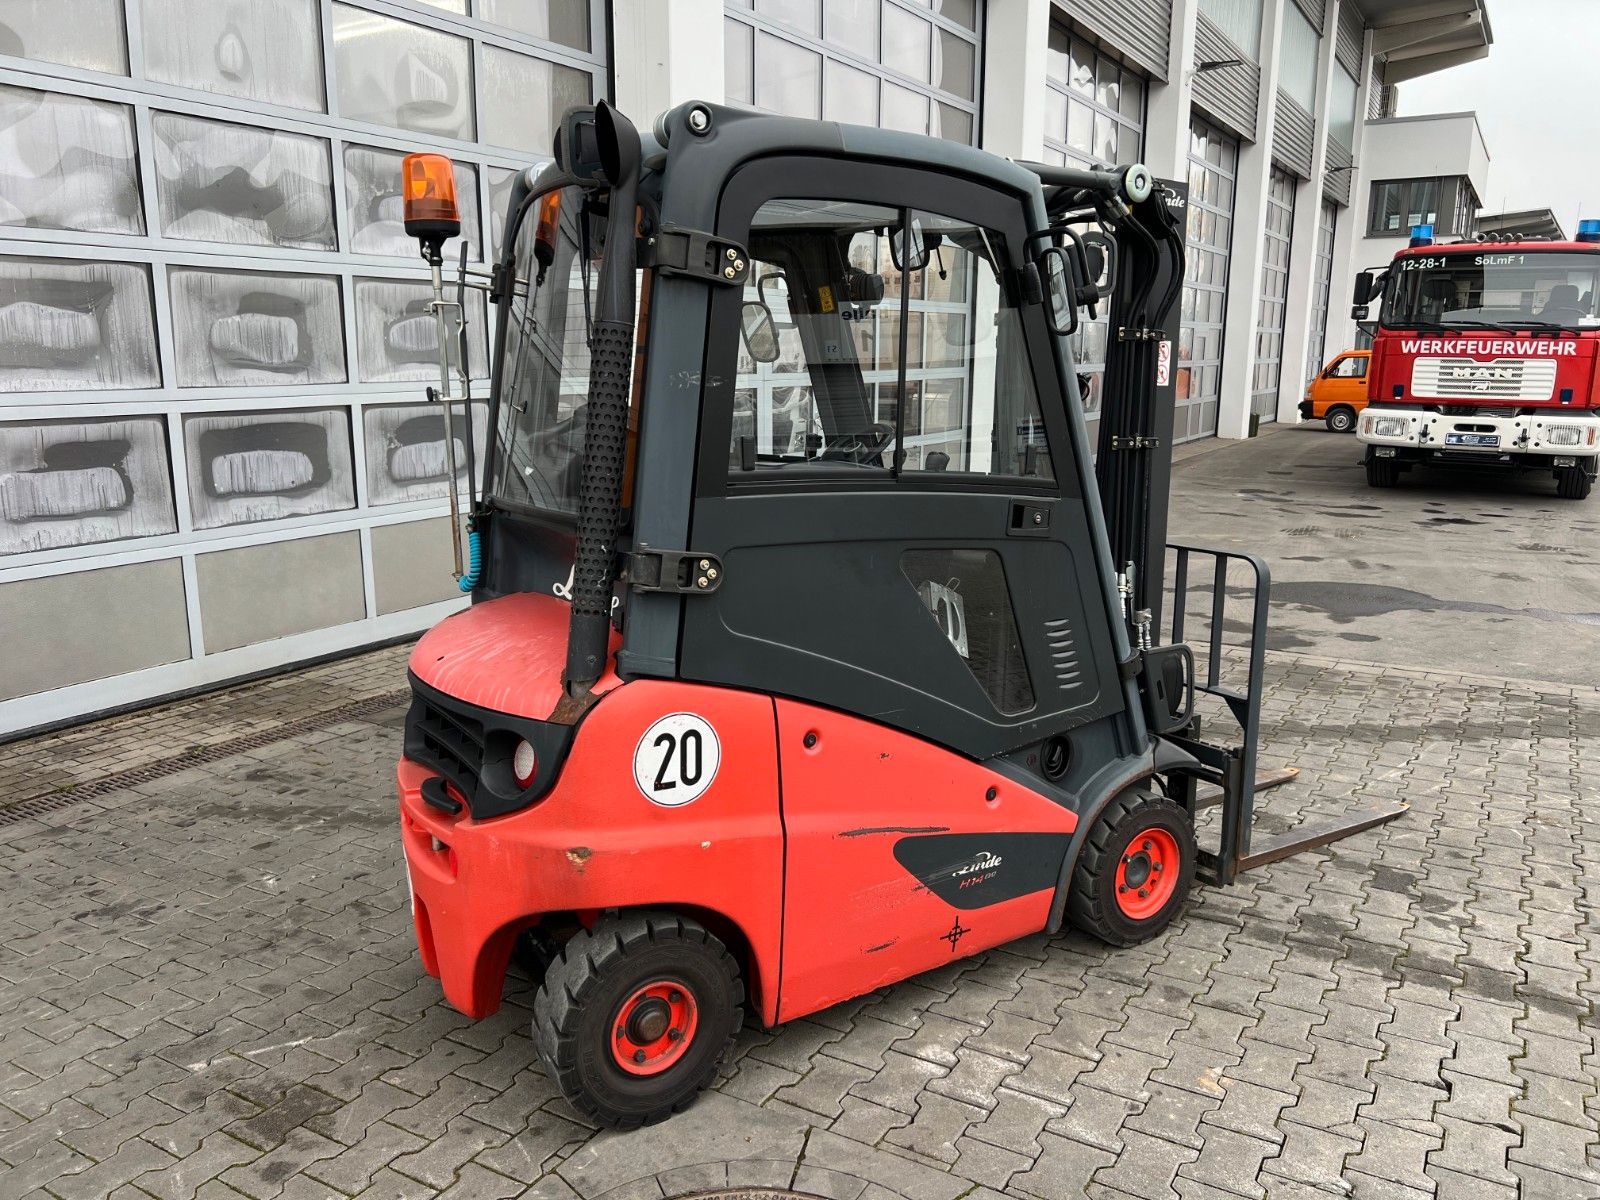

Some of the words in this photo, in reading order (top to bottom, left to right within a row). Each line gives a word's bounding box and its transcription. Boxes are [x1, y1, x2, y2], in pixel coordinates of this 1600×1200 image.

[1401, 257, 1446, 271] 12-28-1
[1474, 255, 1515, 265] SoLmF
[1519, 255, 1525, 265] 1
[1401, 340, 1577, 355] WERKFEUERWEHR
[1452, 367, 1513, 379] MAN
[653, 729, 702, 791] 20
